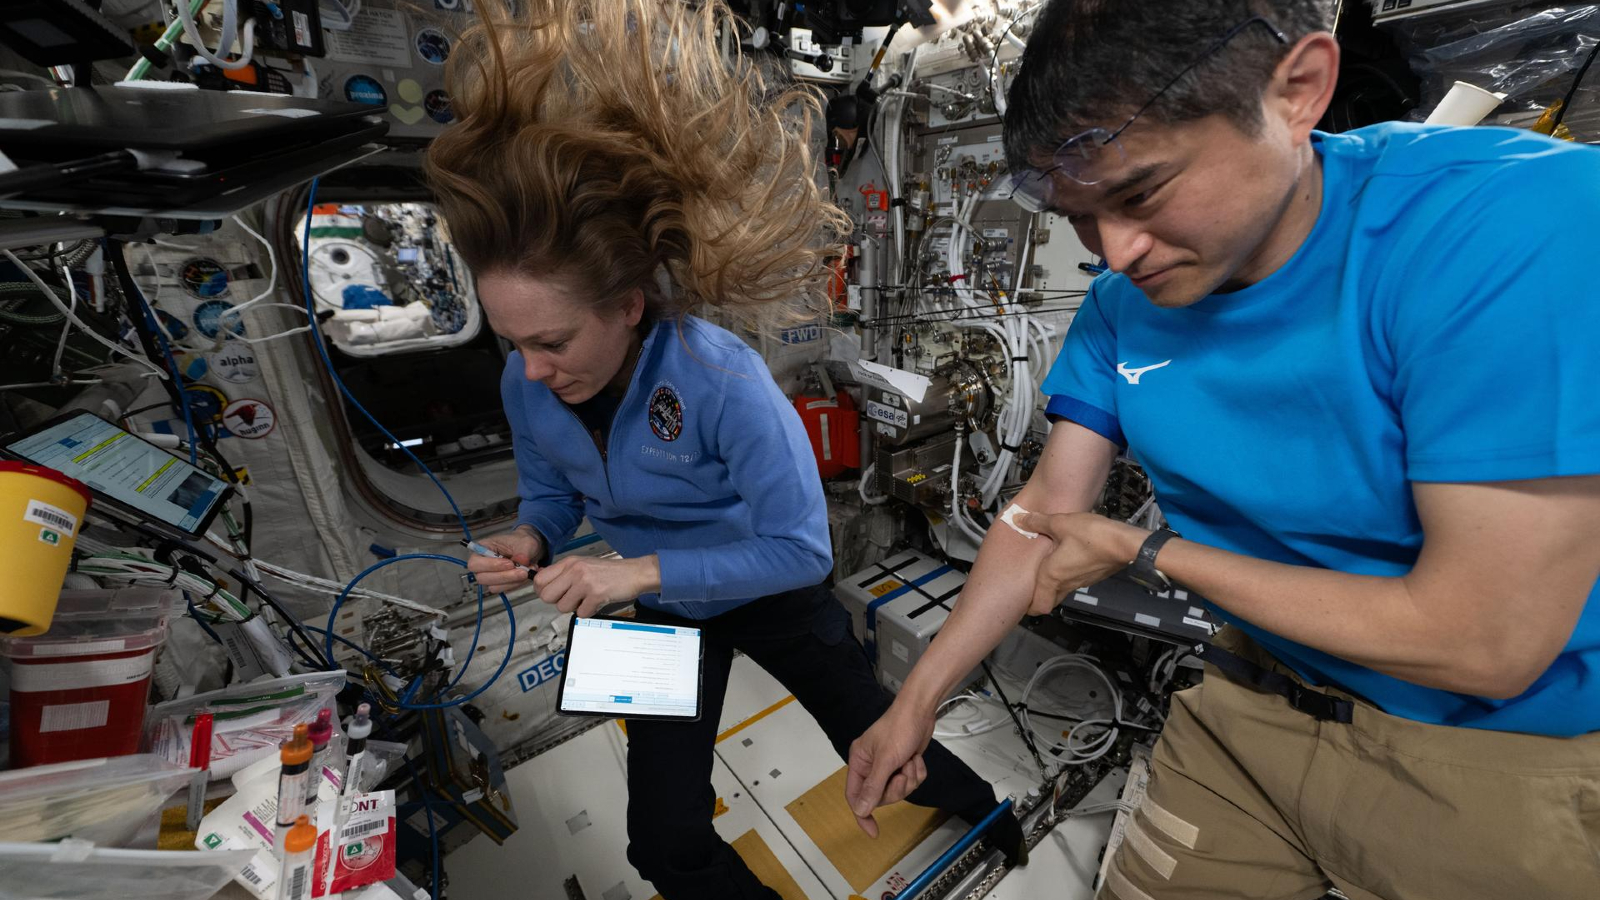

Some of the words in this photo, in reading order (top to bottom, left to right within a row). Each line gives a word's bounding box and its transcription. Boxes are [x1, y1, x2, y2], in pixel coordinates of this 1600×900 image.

[349, 90, 384, 101] proxima
[787, 326, 819, 343] FWD
[219, 355, 255, 367] alpha
[877, 408, 894, 421] esa
[239, 422, 270, 436] huginn
